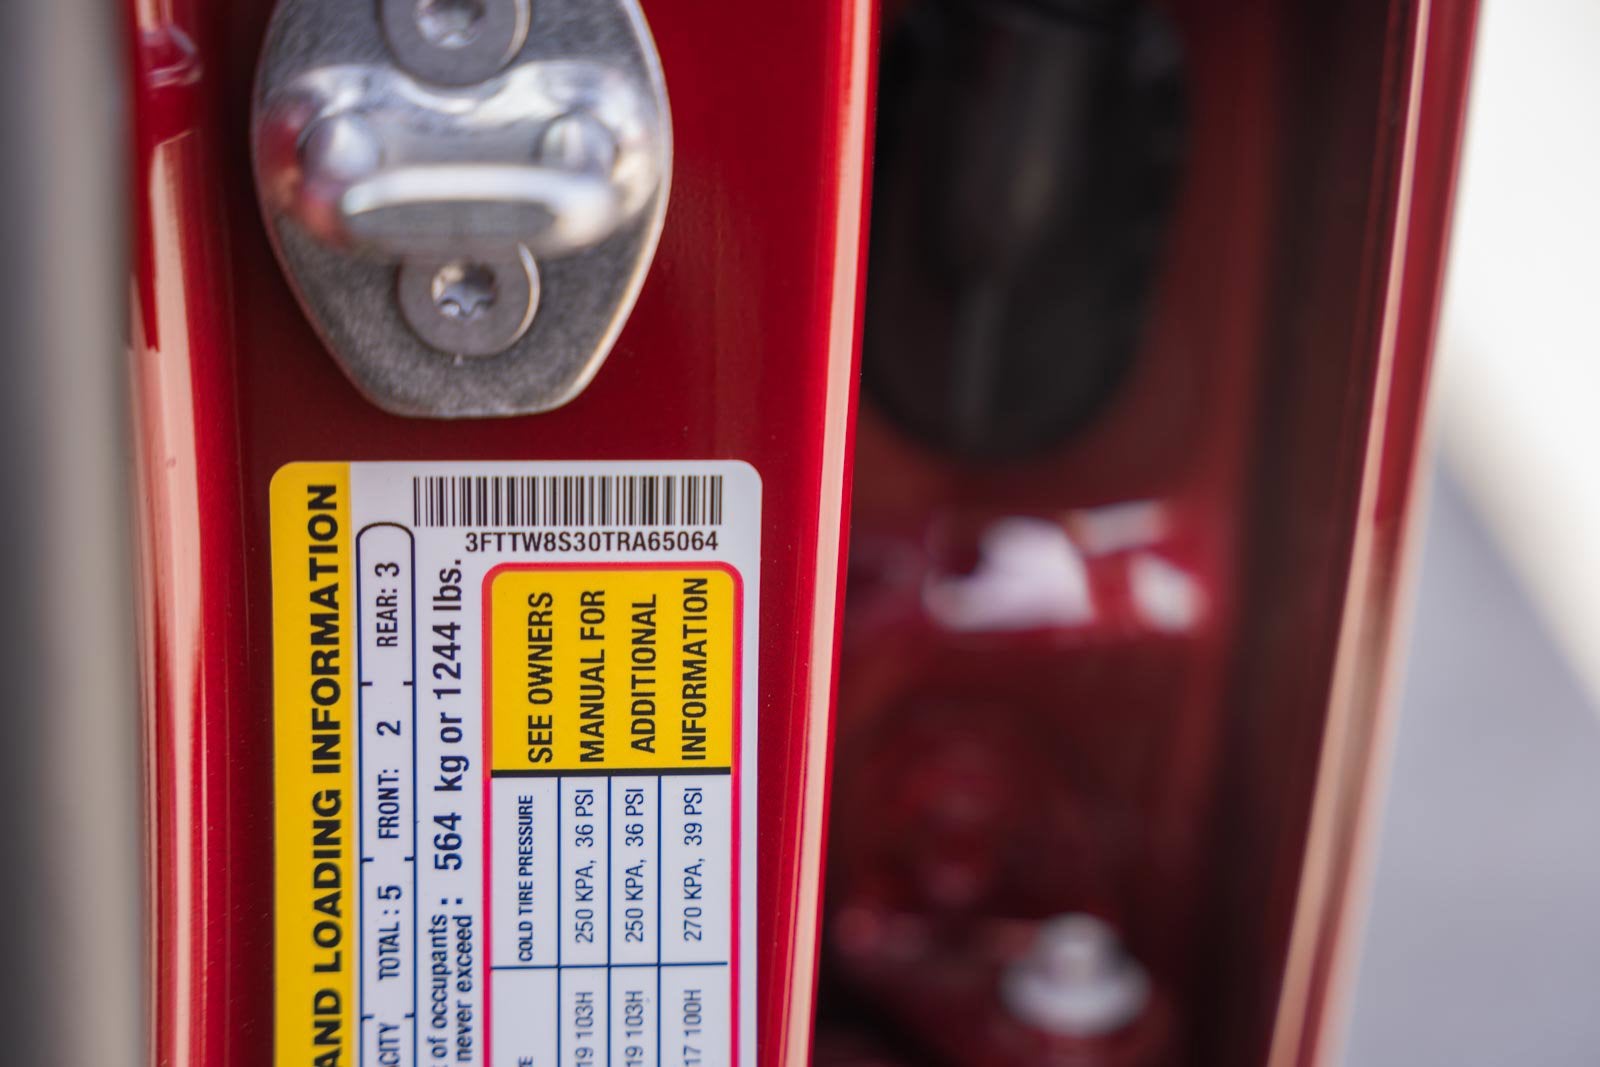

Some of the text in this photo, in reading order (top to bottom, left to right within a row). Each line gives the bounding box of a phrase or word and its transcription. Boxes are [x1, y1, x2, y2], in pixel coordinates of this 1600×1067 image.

[464, 530, 718, 552] 3FTTW8S30TRA65064
[374, 562, 401, 647] REAR: 3
[432, 559, 462, 611] lbs.
[432, 622, 462, 700] 1244
[526, 592, 554, 763] SEE OWNERS
[579, 590, 606, 763] MANUAL FOR
[630, 594, 657, 754] ADDITIONAL
[681, 578, 708, 761] INFORMATION
[440, 711, 463, 744] or
[306, 484, 343, 1067] AND LOADING INFORMATION
[375, 720, 401, 840] FRONT: 2
[433, 755, 470, 792] kg
[432, 812, 463, 871] 564
[517, 795, 535, 962] COLD TIRE PRESSURE
[573, 789, 599, 944] 250 KPA, 36 PSI
[623, 788, 649, 943] 250 KPA, 36 PSI
[682, 786, 708, 942] 270 KPA, 39 PSI
[377, 885, 403, 901] 5
[427, 914, 453, 1030] occupants
[452, 914, 474, 1063] never exceed
[624, 990, 644, 1038] 103H
[682, 989, 703, 1037] 100H
[378, 1023, 401, 1067] CITY
[426, 1036, 449, 1059] of
[574, 991, 594, 1040] 103H
